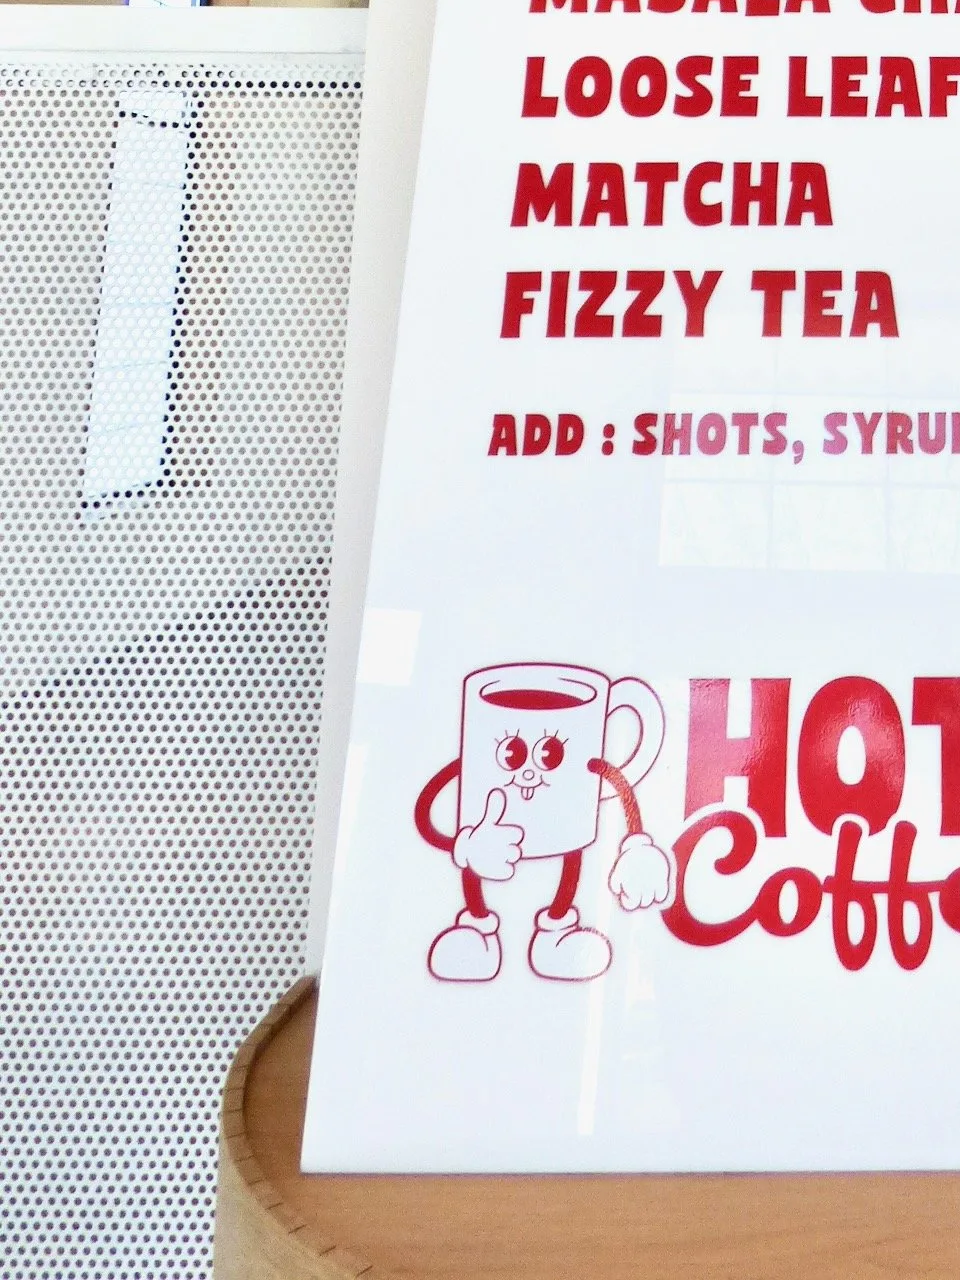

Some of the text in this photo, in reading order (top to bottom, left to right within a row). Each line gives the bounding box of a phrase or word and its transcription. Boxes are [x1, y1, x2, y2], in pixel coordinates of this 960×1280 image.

[520, 55, 761, 119] LOOSE
[510, 161, 834, 228] MATCHA
[499, 269, 724, 340] FIZZY
[750, 270, 900, 339] TEA
[487, 413, 586, 457] ADD
[631, 411, 805, 464] SHOTS,
